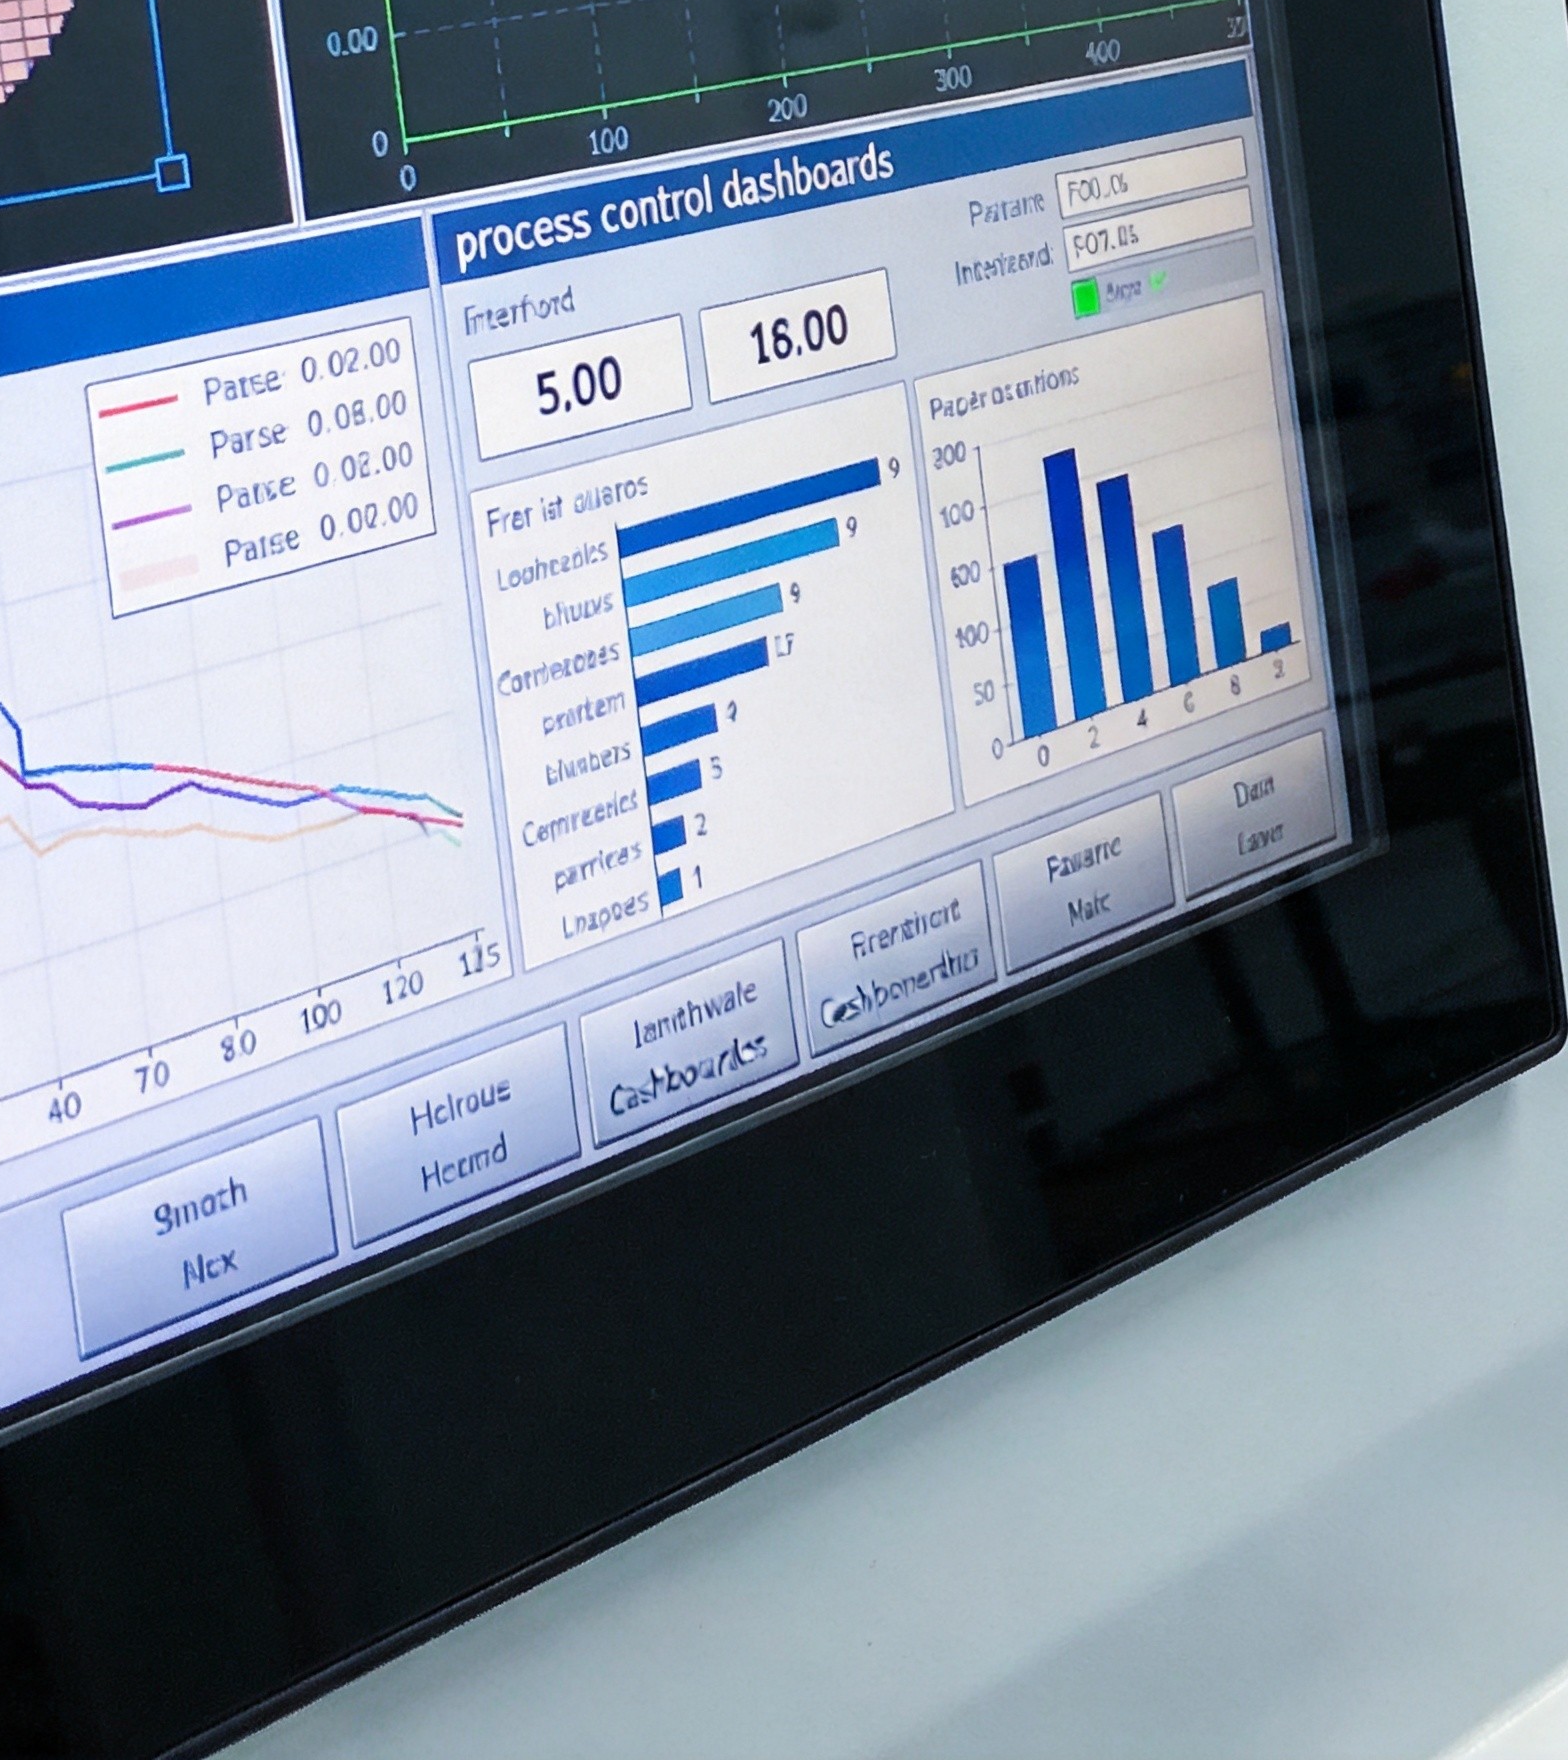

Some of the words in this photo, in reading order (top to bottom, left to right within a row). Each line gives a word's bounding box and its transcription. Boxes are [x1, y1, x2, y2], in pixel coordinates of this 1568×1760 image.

[327, 25, 379, 58] 0.00
[372, 130, 389, 158] 0
[399, 164, 417, 192] 0
[588, 125, 629, 156] 100
[767, 93, 808, 124] 200
[455, 207, 591, 273] process
[600, 173, 713, 234] control
[722, 141, 895, 210] dashboards
[536, 354, 622, 416] 5.00
[888, 456, 900, 479] 9
[846, 515, 859, 539] 9
[973, 679, 996, 707] 50
[991, 737, 1005, 761] 0
[1037, 744, 1051, 767] 0
[1088, 726, 1101, 750] 2
[695, 811, 708, 837] 2
[692, 864, 703, 890] 1
[48, 1090, 83, 1124] 40
[133, 1059, 171, 1095] 70
[299, 999, 343, 1035] 100
[382, 969, 425, 1006] 120
